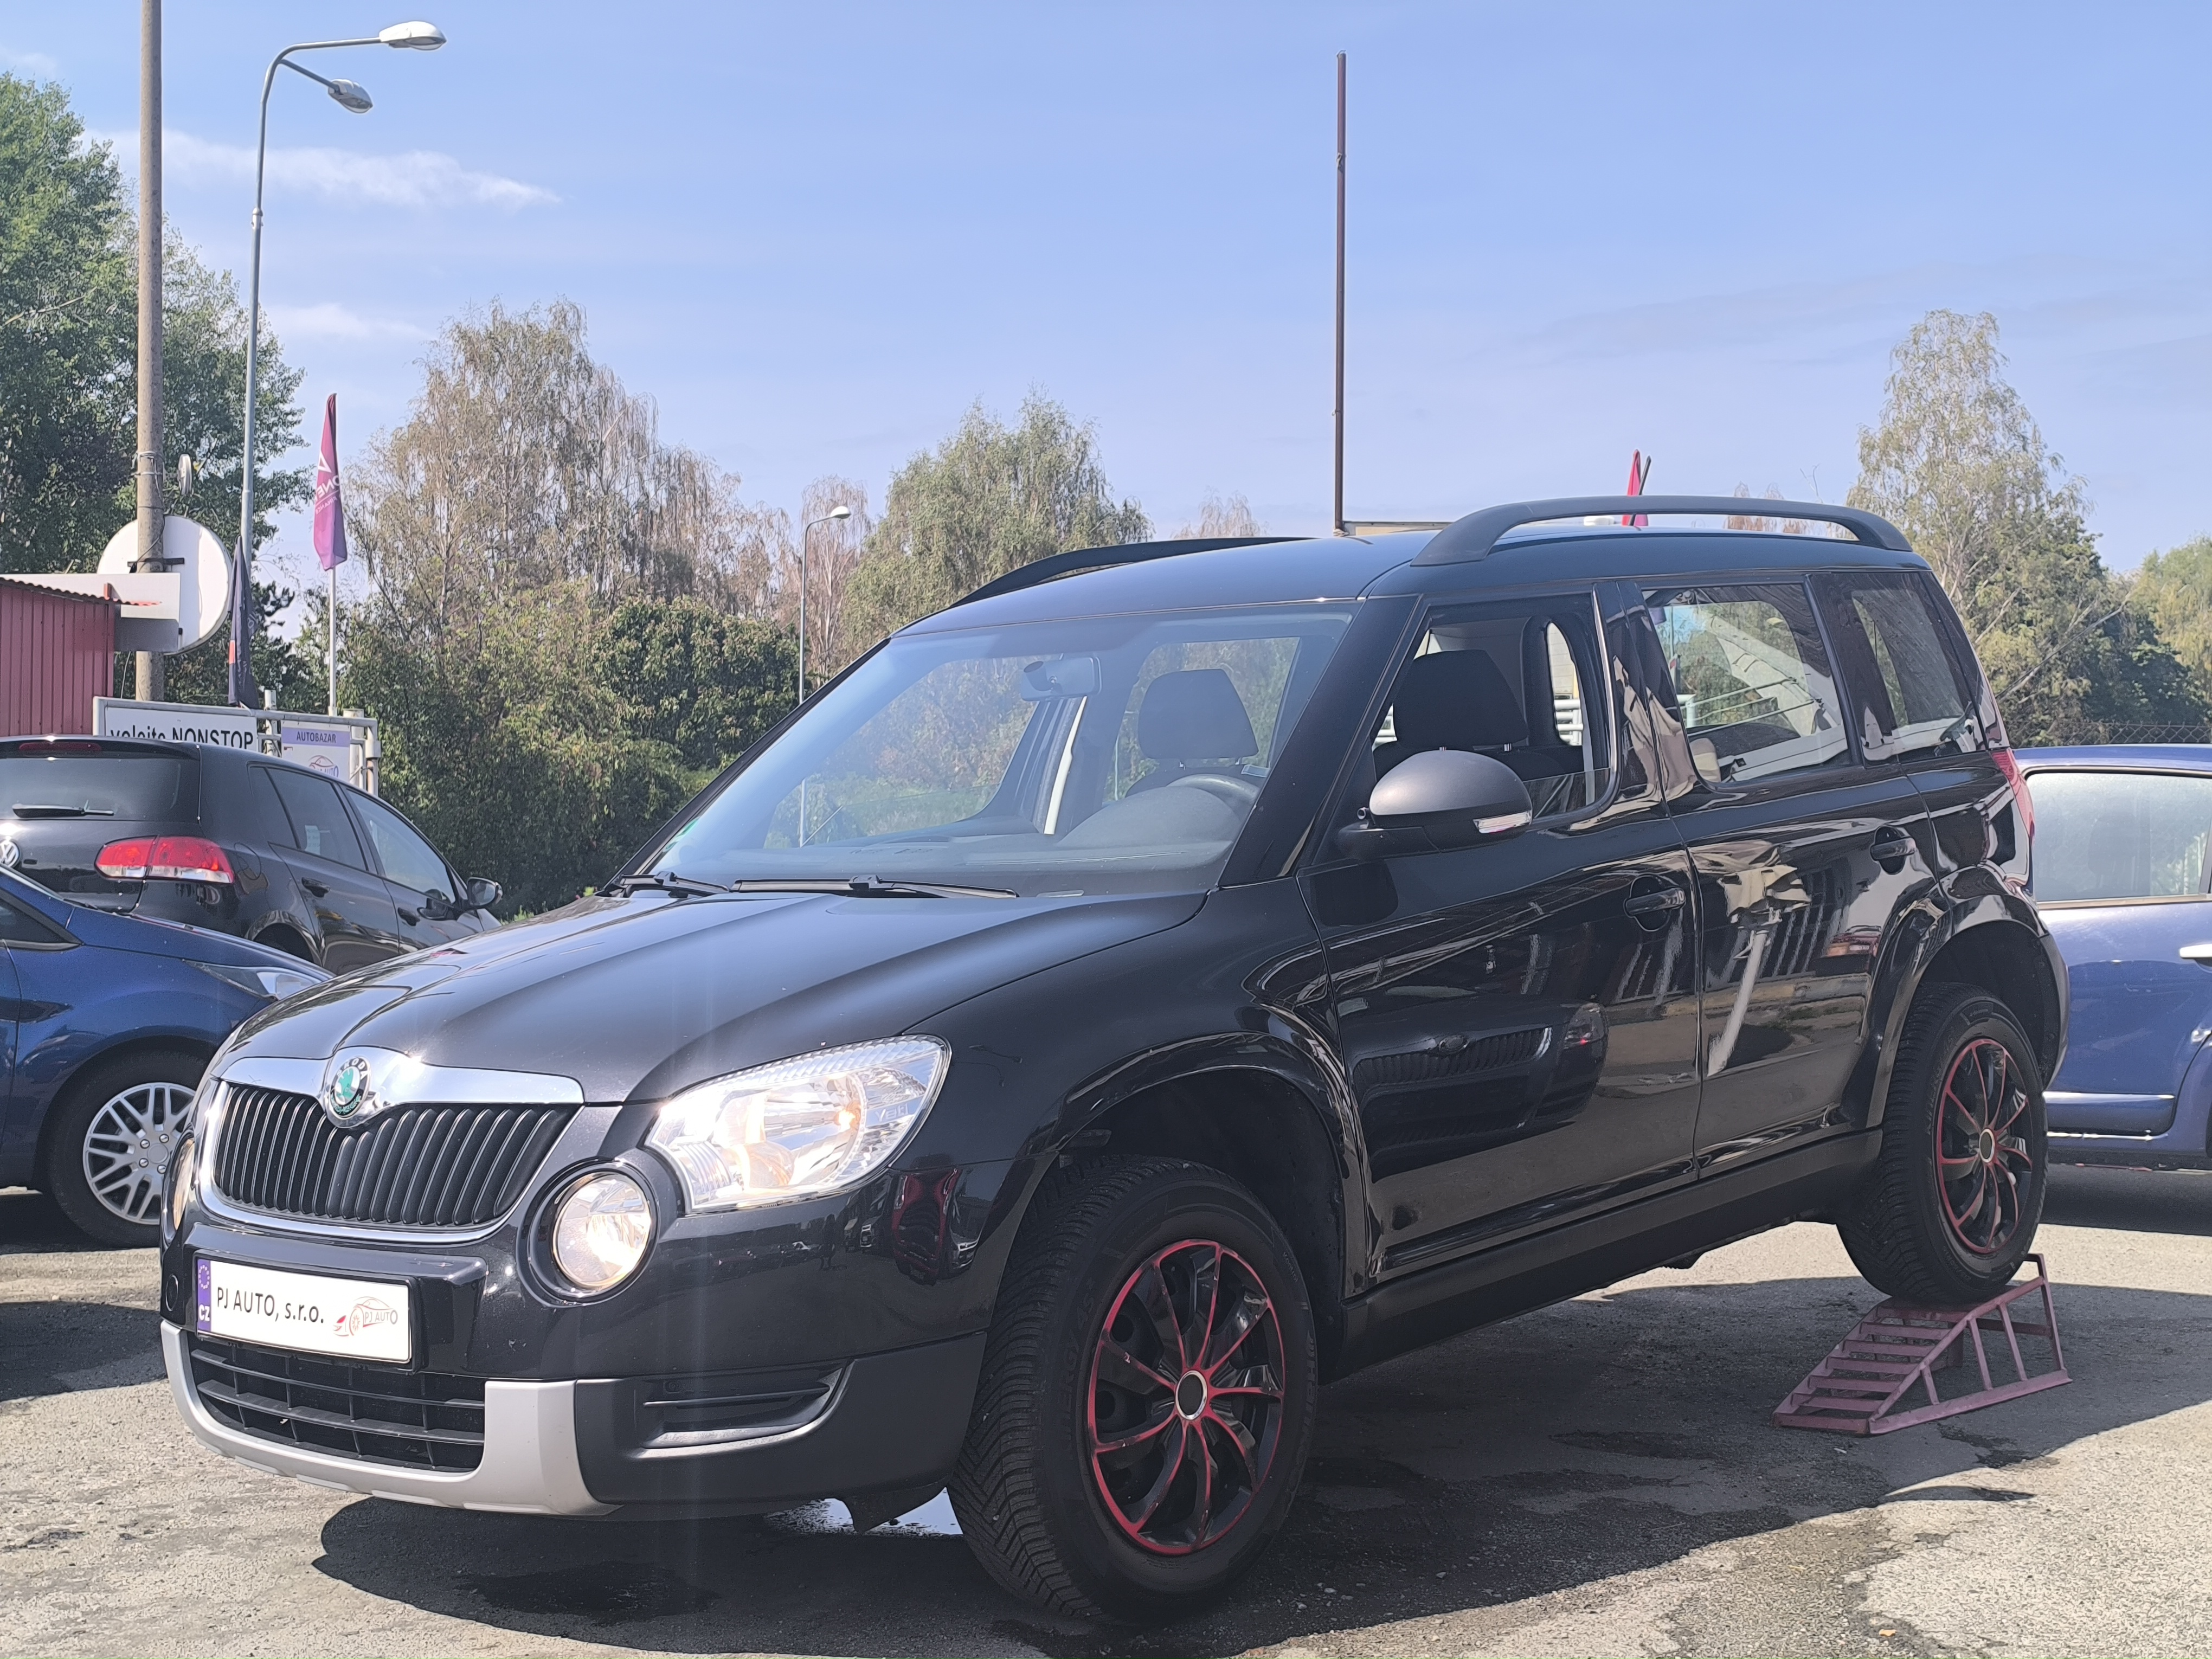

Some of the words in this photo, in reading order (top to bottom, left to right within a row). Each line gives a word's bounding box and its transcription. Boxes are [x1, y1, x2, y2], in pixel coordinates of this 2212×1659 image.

[172, 726, 253, 750] NONSTOP
[296, 731, 336, 744] AUTOBAZAR
[198, 1304, 210, 1322] CZ
[217, 1286, 229, 1309] PJ
[233, 1289, 279, 1322] AUTO,
[285, 1302, 325, 1323] s.r.o.
[376, 1309, 398, 1325] AUTO
